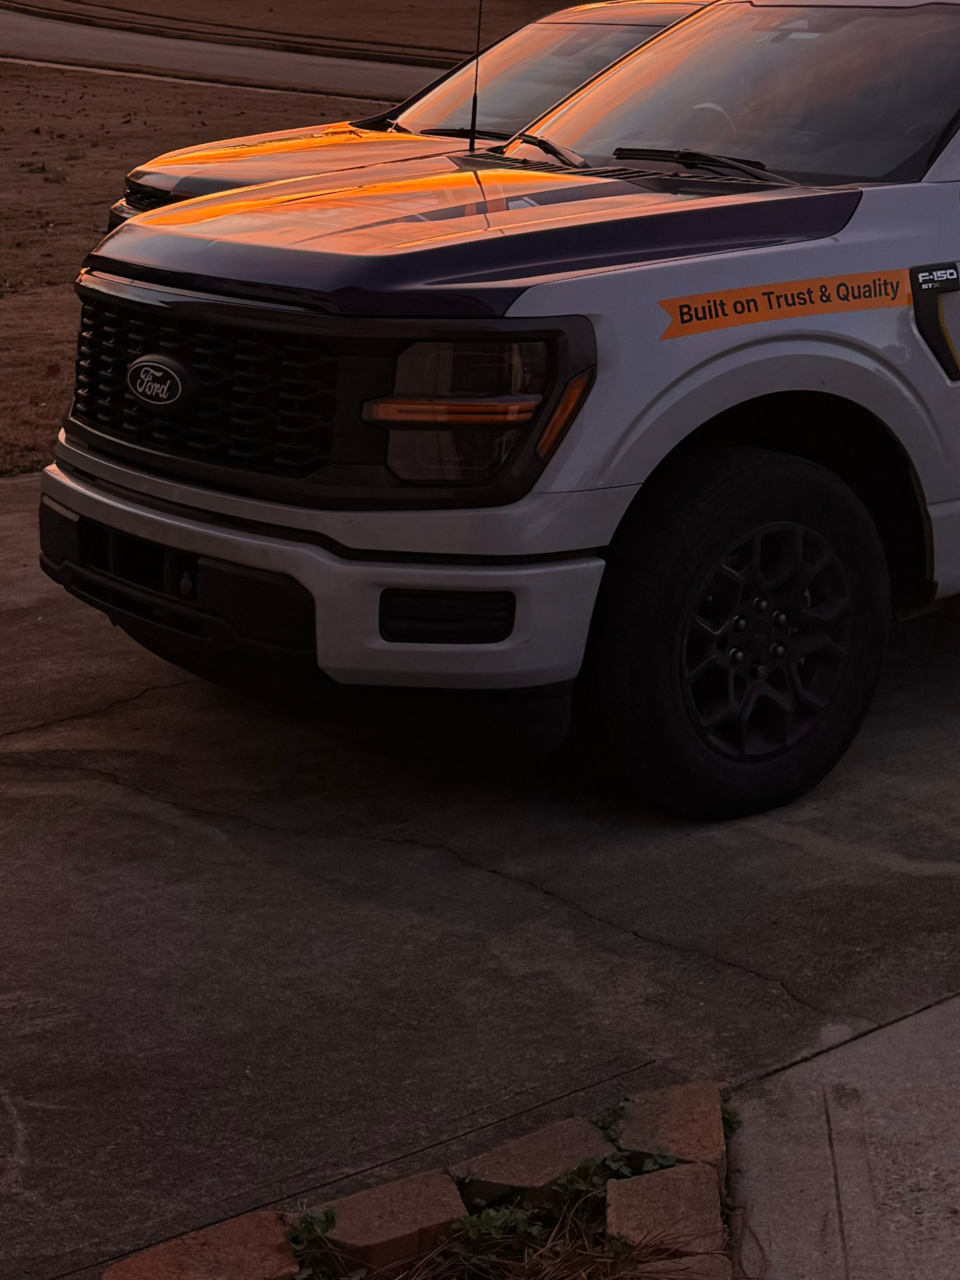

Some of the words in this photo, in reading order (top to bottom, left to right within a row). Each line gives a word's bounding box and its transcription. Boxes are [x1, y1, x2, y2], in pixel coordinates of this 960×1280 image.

[918, 269, 958, 284] F-150
[679, 299, 728, 325] Built
[733, 297, 759, 315] on
[762, 287, 815, 310] Trust
[819, 284, 832, 303] &
[836, 278, 900, 303] Quality
[136, 367, 171, 399] Ford
